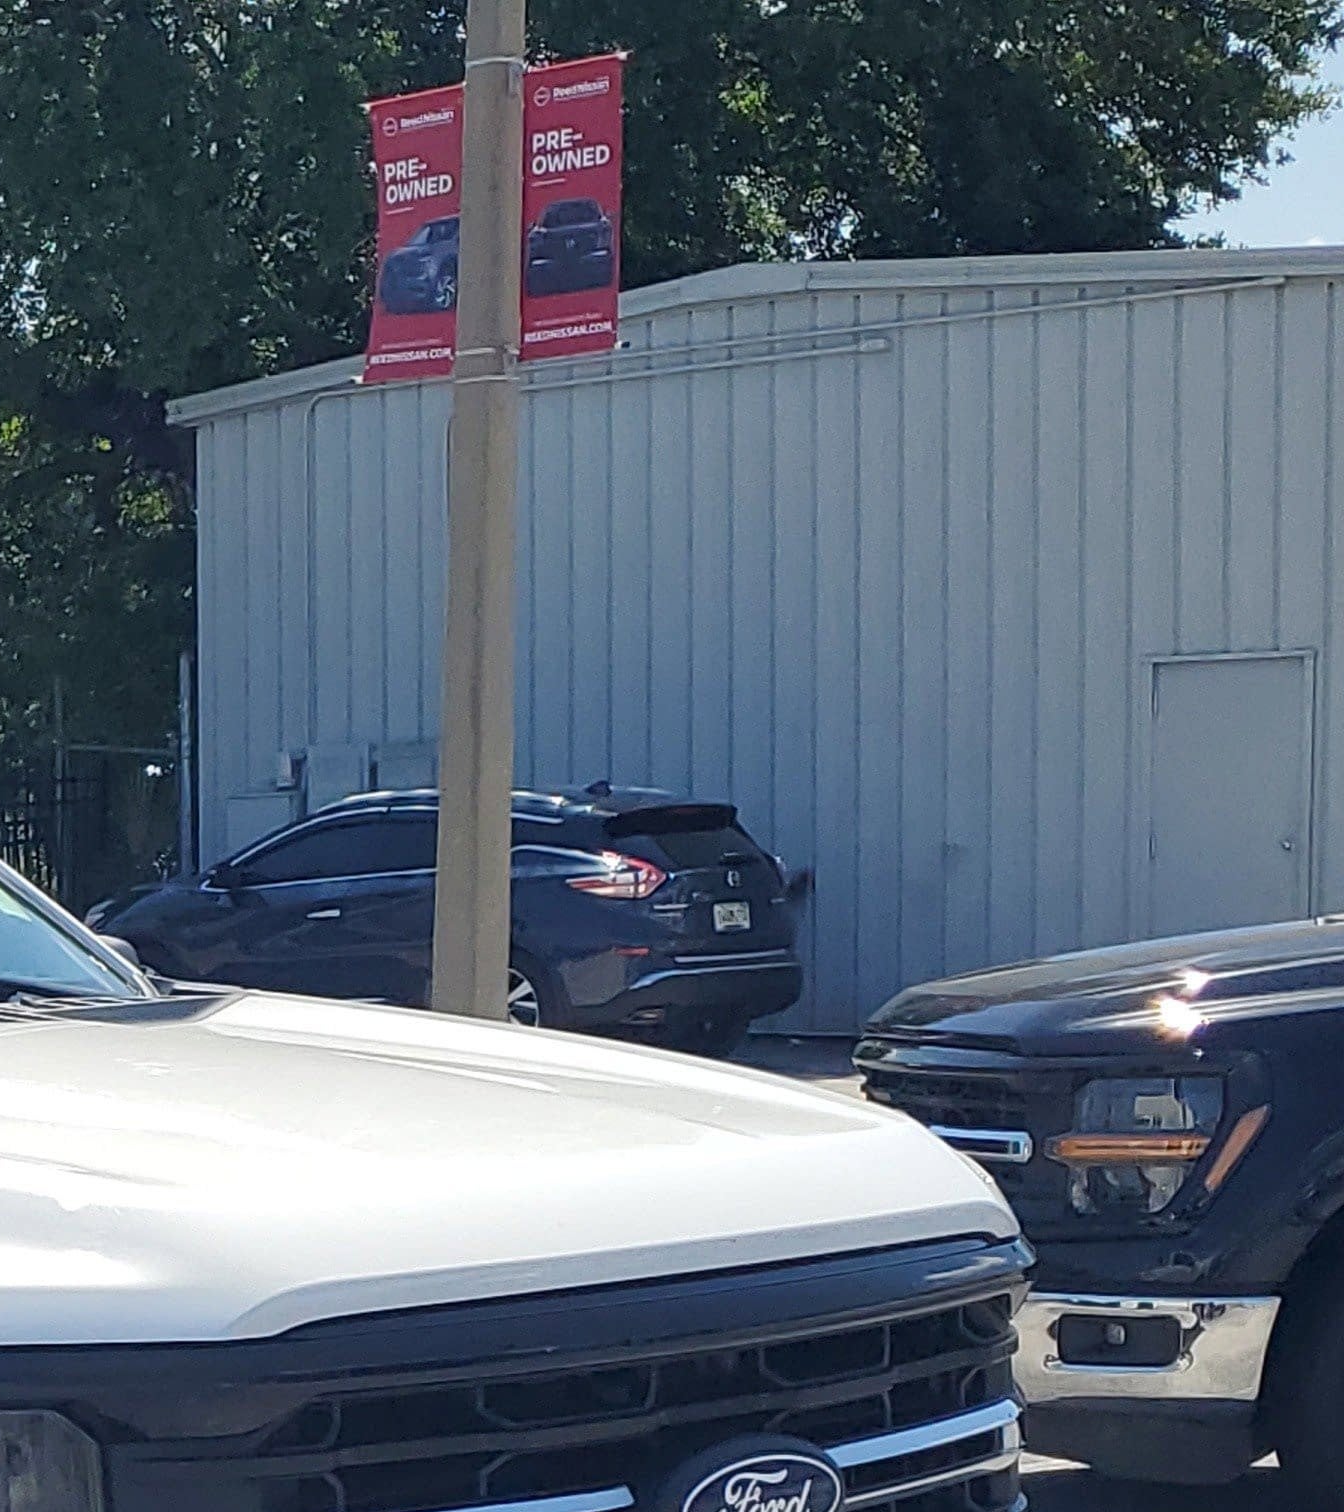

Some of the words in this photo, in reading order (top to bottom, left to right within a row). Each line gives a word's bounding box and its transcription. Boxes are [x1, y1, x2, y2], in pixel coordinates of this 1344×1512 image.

[532, 128, 583, 153] PRE-
[384, 157, 427, 183] PRE-
[531, 145, 611, 175] OWNED
[386, 174, 454, 204] OWNED
